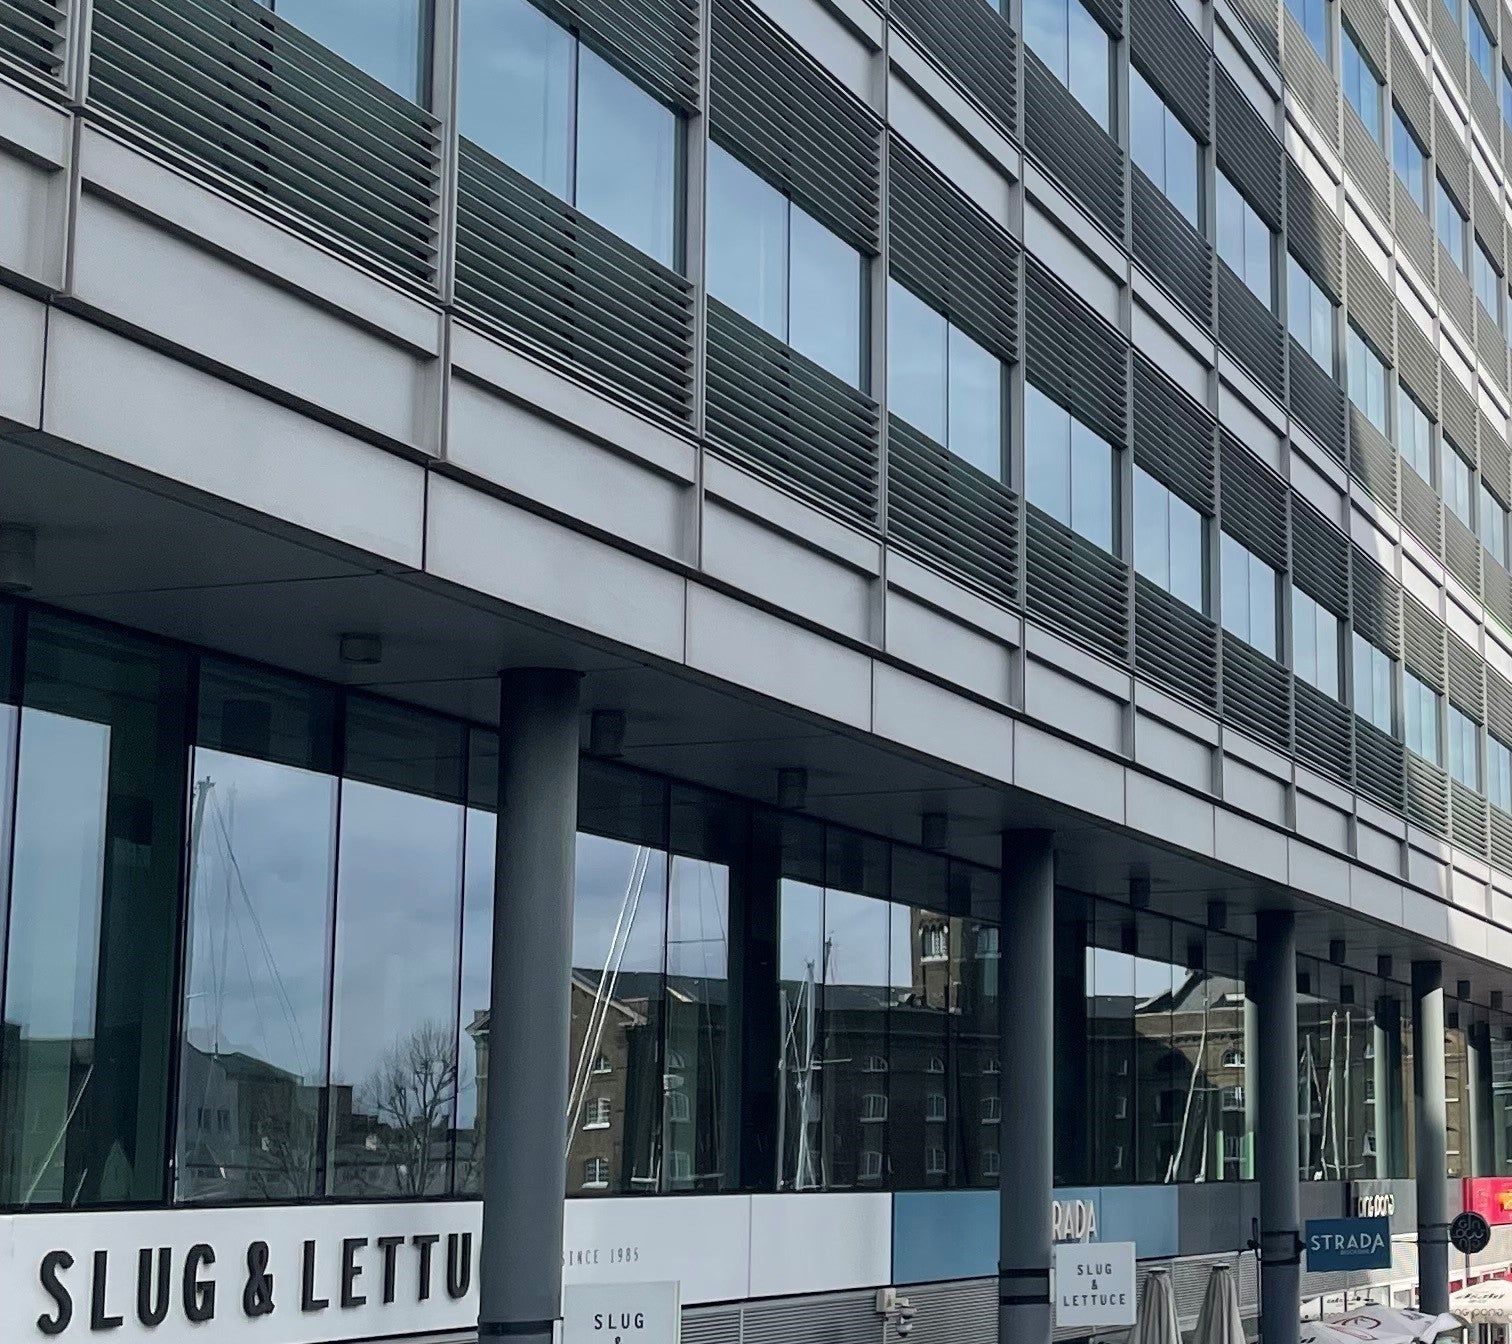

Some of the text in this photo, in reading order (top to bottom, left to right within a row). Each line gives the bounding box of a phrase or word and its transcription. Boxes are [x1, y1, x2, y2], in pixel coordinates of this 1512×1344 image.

[1052, 1199, 1098, 1243] RADA
[1310, 1232, 1386, 1254] STRADA
[562, 1249, 600, 1266] INCE
[1077, 1263, 1113, 1276] SLUG
[36, 1242, 217, 1336] SLUG
[242, 1240, 276, 1318] &
[1090, 1279, 1099, 1290] &
[1063, 1293, 1127, 1307] LETTUCE
[594, 1312, 645, 1330] SLUG
